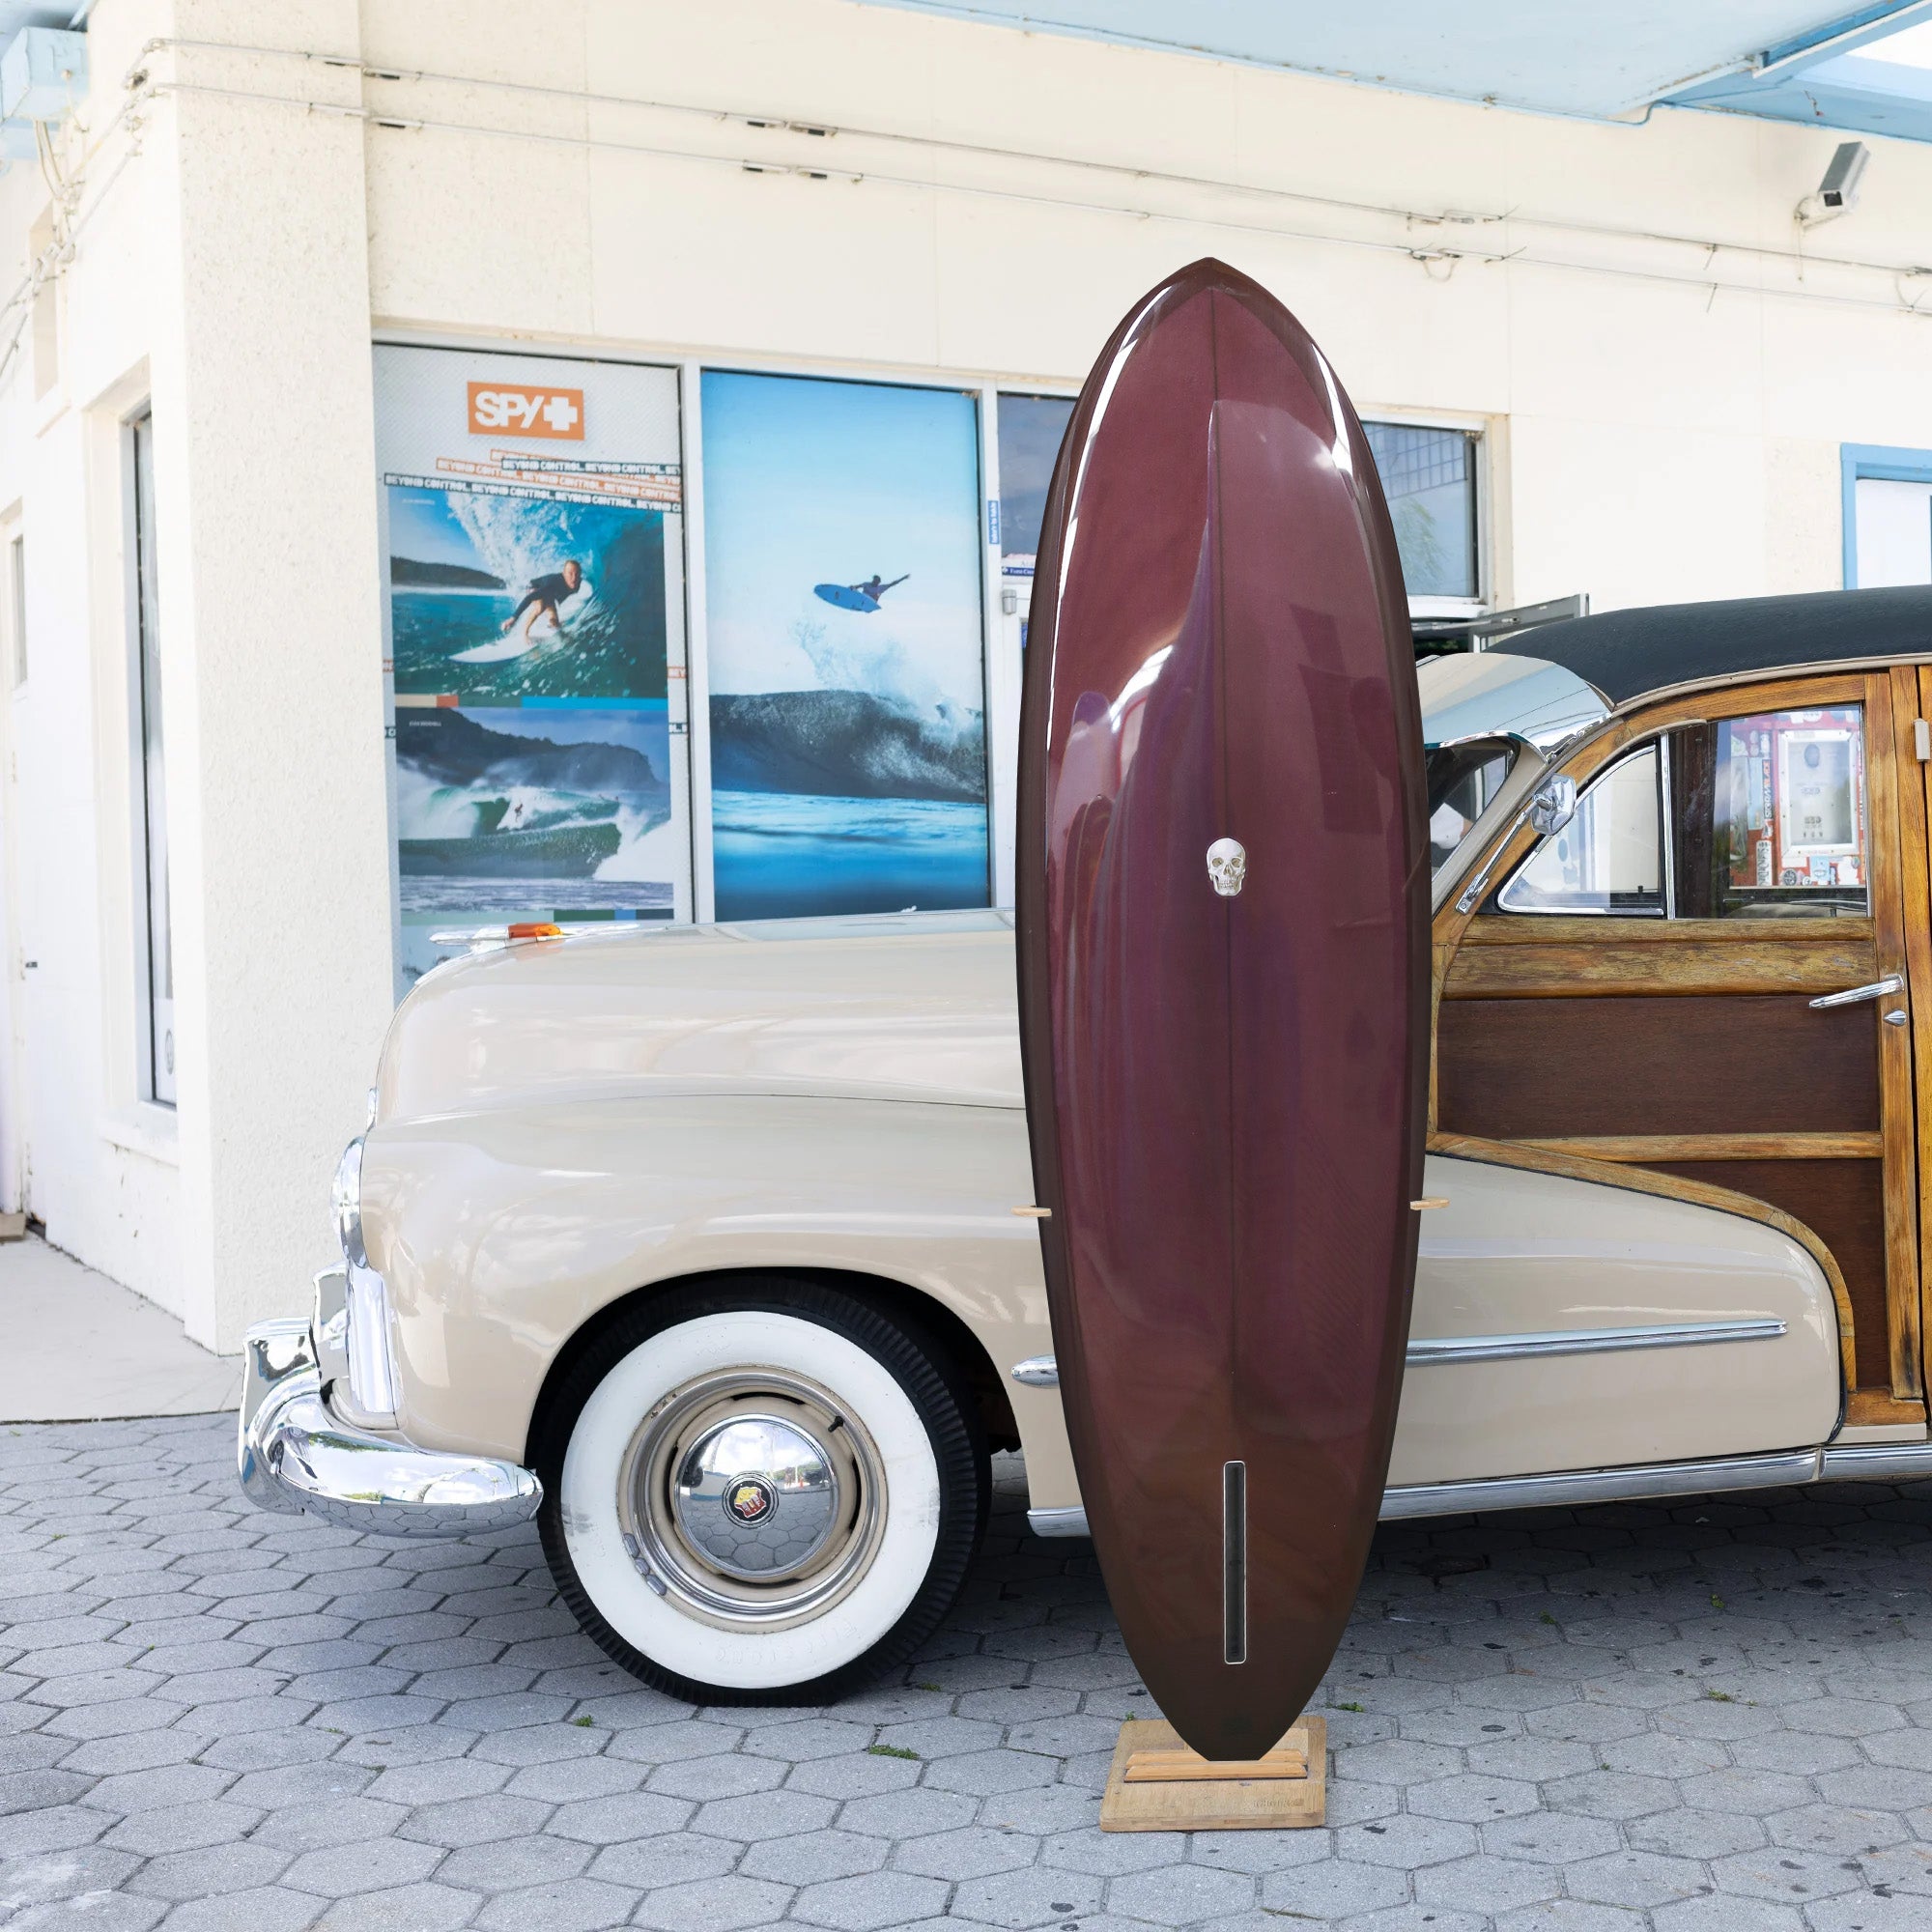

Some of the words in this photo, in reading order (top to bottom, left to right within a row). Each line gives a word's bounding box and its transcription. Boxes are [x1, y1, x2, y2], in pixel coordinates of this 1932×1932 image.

[502, 460, 539, 470] BEYOND
[585, 463, 620, 473] BEYOND
[386, 475, 423, 488] BEYOND
[471, 483, 509, 496] BEYOND
[555, 491, 591, 503] BEYOND
[637, 499, 671, 511] BEYOND
[605, 482, 639, 496] BEYOND
